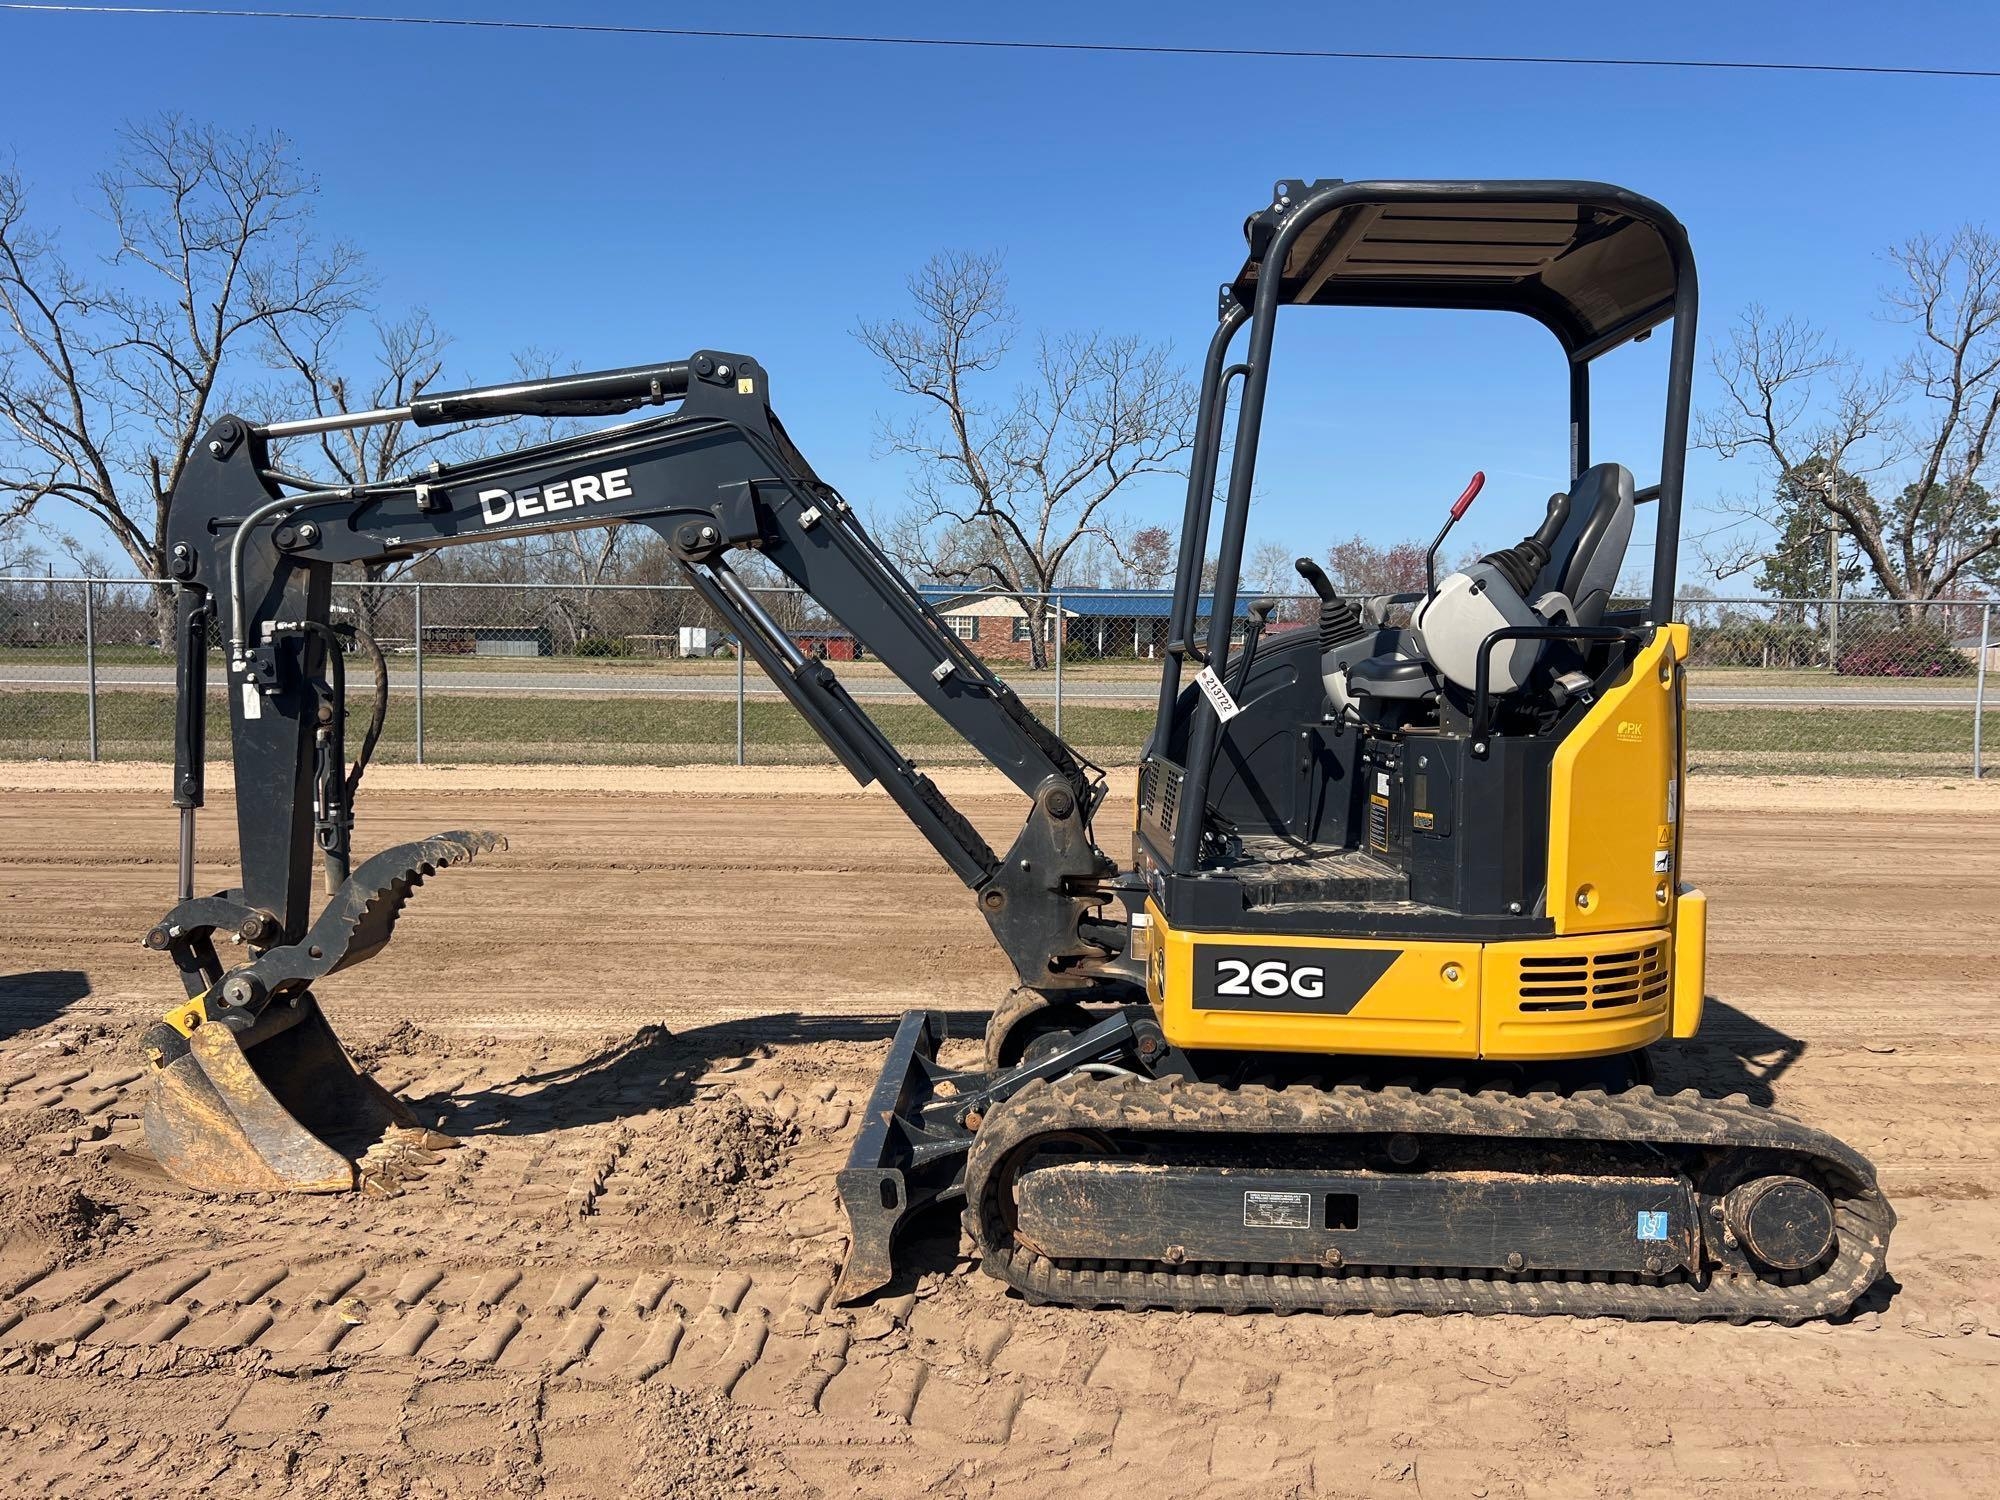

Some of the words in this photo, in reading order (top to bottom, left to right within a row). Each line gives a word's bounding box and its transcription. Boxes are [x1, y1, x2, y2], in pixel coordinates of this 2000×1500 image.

[478, 467, 633, 525] DEERE
[1206, 677, 1233, 713] 213722
[1216, 959, 1324, 998] 26G
